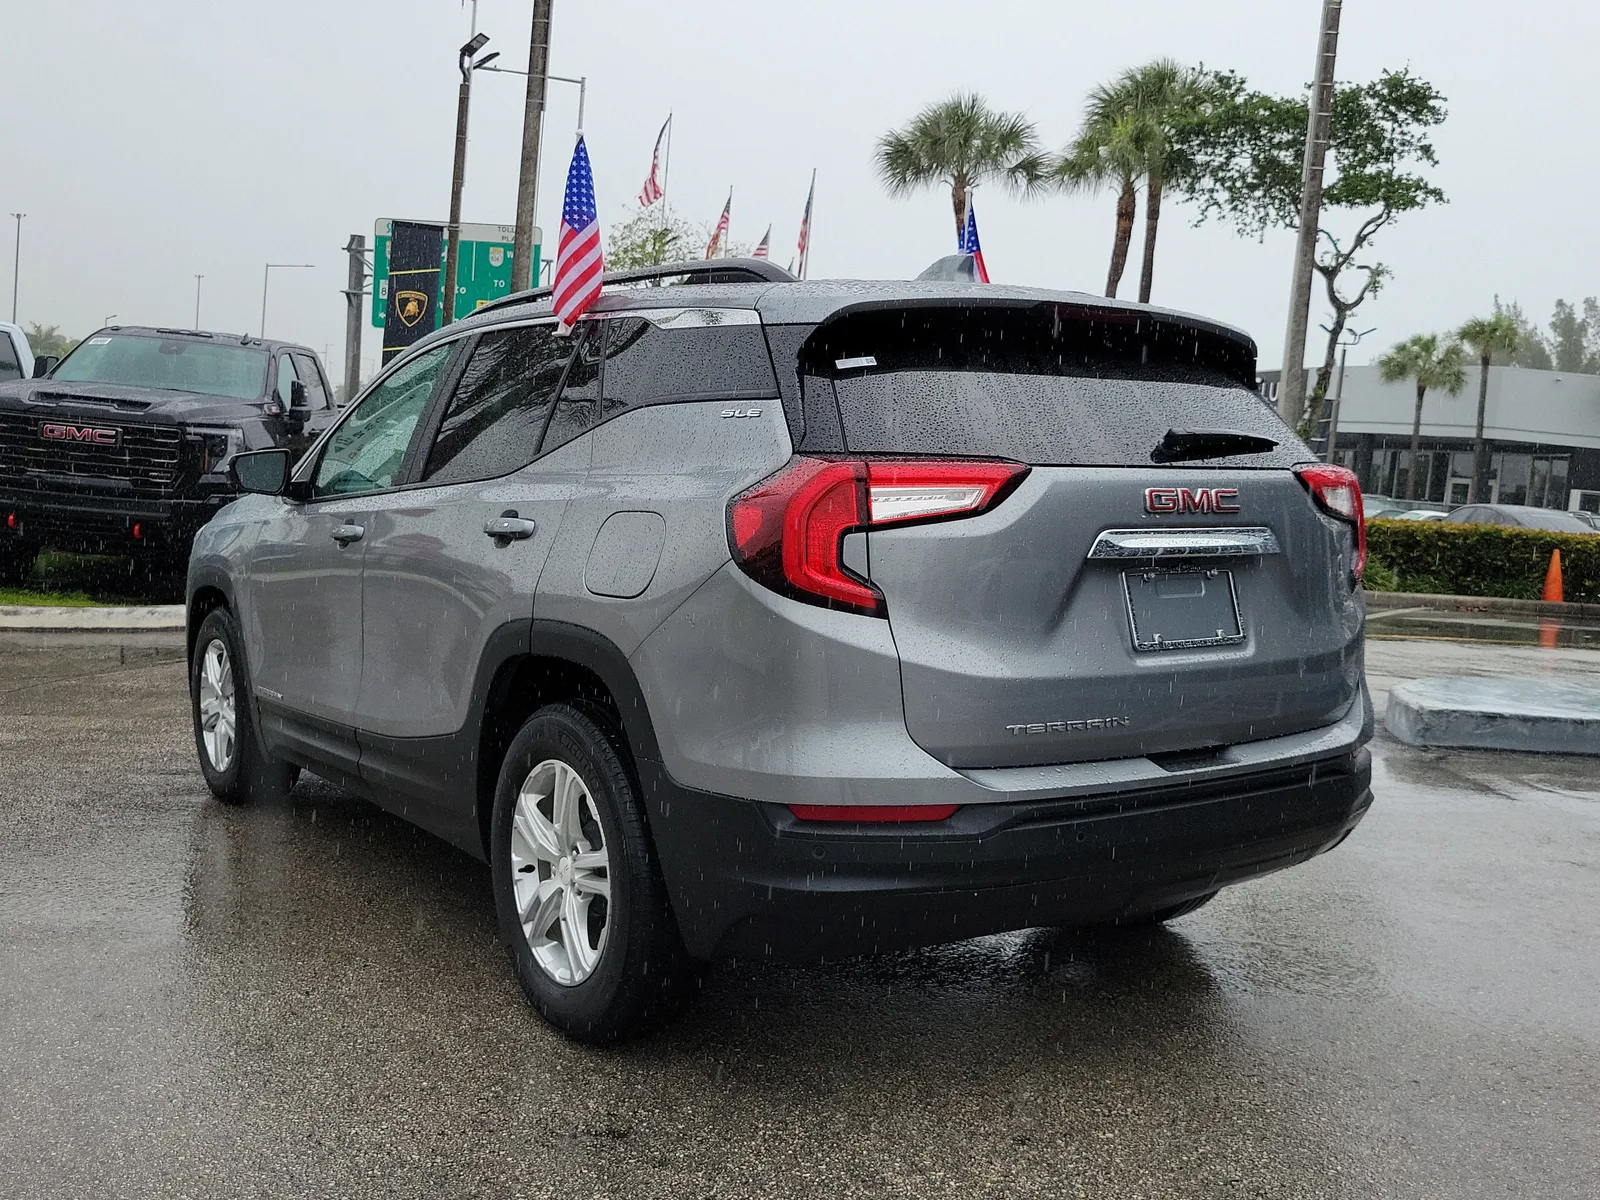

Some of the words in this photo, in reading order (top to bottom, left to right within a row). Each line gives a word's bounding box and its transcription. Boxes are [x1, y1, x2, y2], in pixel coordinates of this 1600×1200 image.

[493, 279, 505, 288] TO
[720, 408, 762, 418] SLE
[43, 424, 116, 443] GMC
[1144, 487, 1240, 513] GMC
[1005, 716, 1130, 735] TERRAIN
